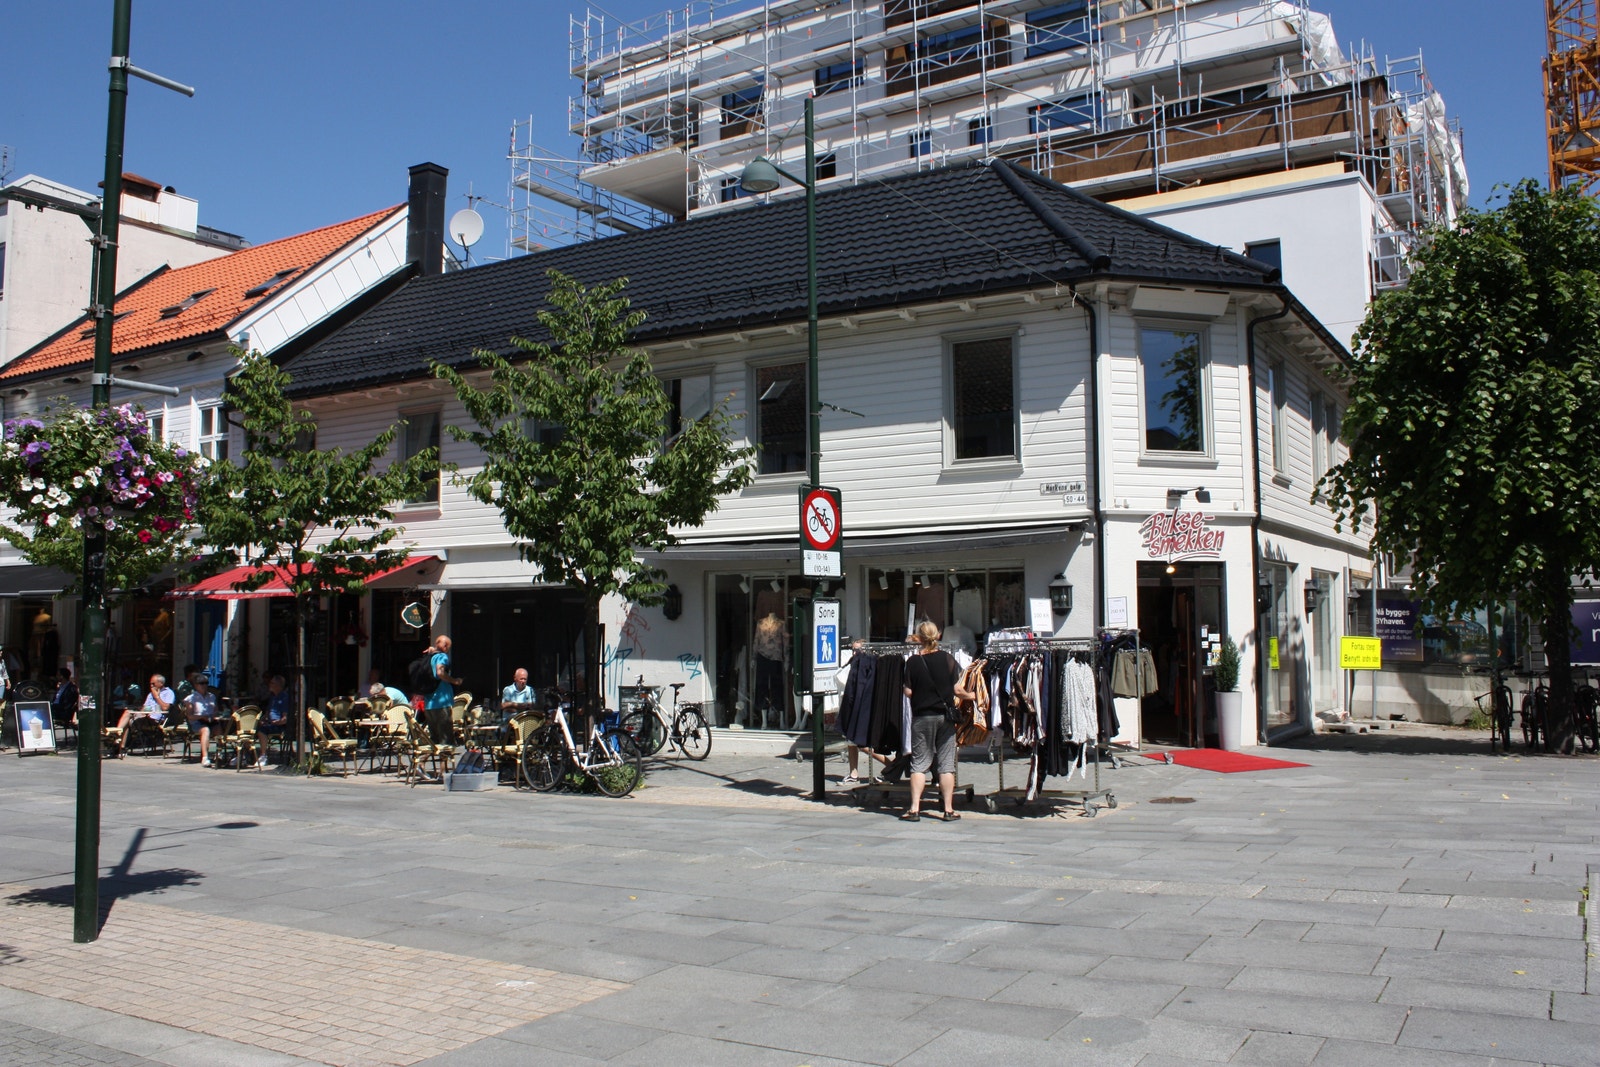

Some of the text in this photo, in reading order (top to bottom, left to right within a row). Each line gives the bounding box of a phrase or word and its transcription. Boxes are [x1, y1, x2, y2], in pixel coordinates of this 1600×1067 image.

[1142, 507, 1215, 543] Bukse-
[1149, 527, 1225, 556] smekken
[818, 606, 835, 618] Sone
[1385, 608, 1409, 617] bygges
